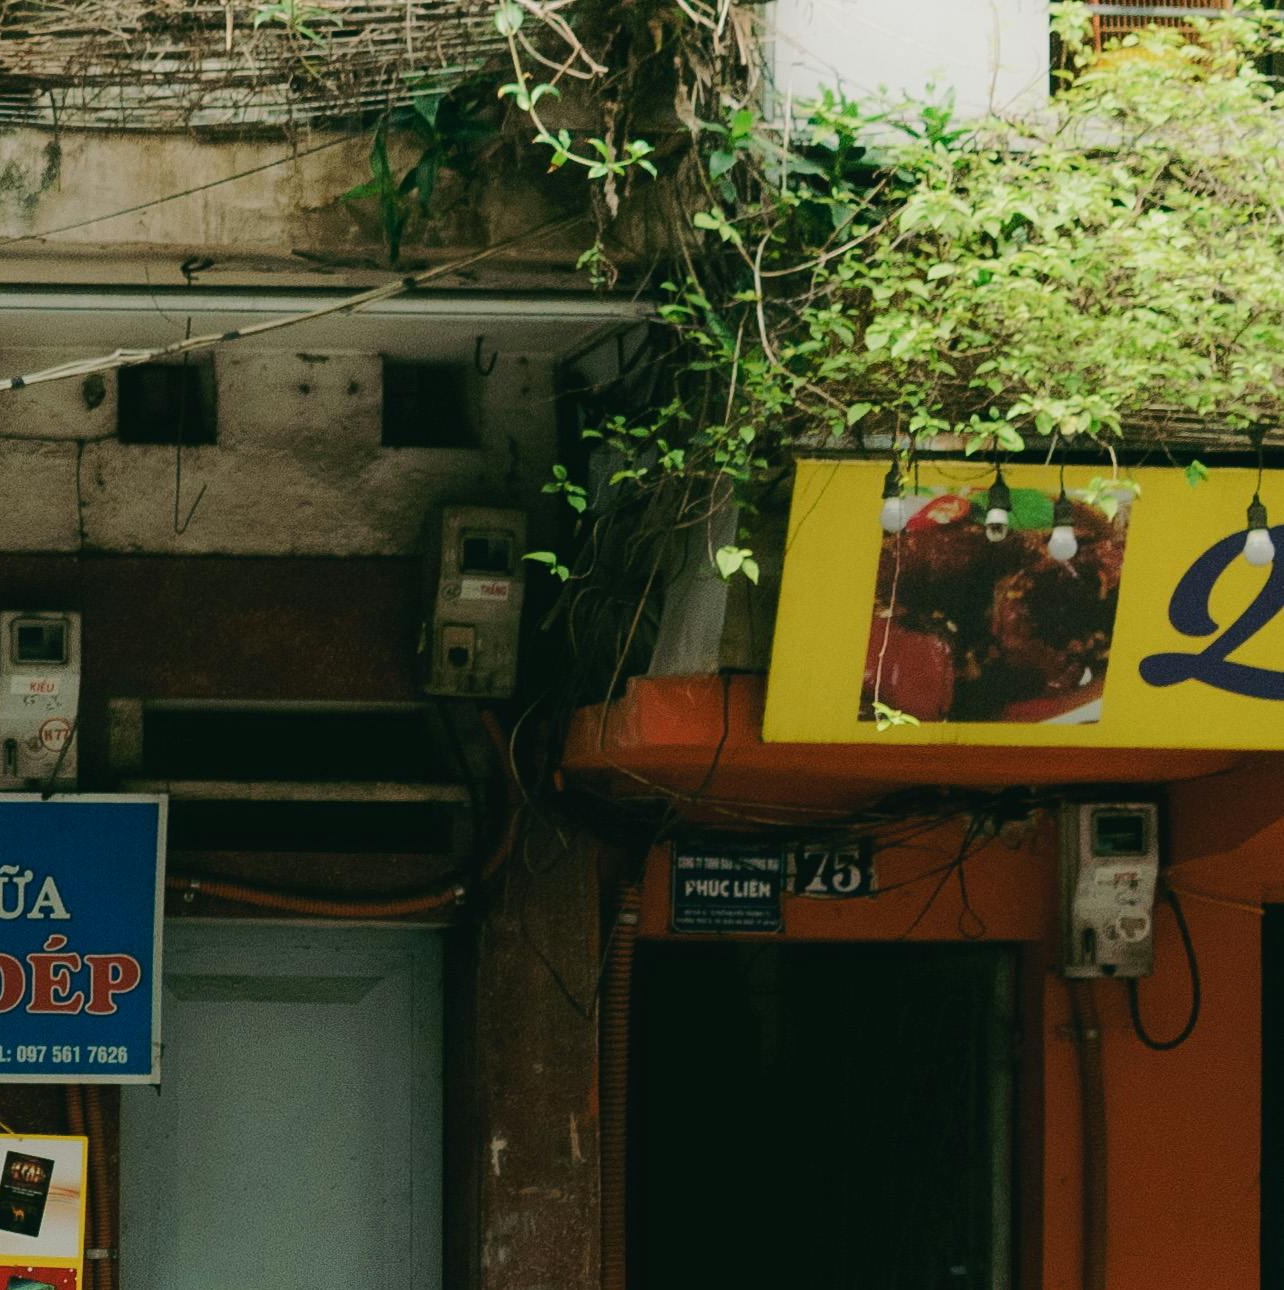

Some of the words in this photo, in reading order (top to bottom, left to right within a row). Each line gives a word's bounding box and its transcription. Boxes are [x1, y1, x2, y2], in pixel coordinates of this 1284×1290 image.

[803, 852, 863, 893] 75
[16, 1044, 48, 1064] 097
[51, 1044, 81, 1064] 561
